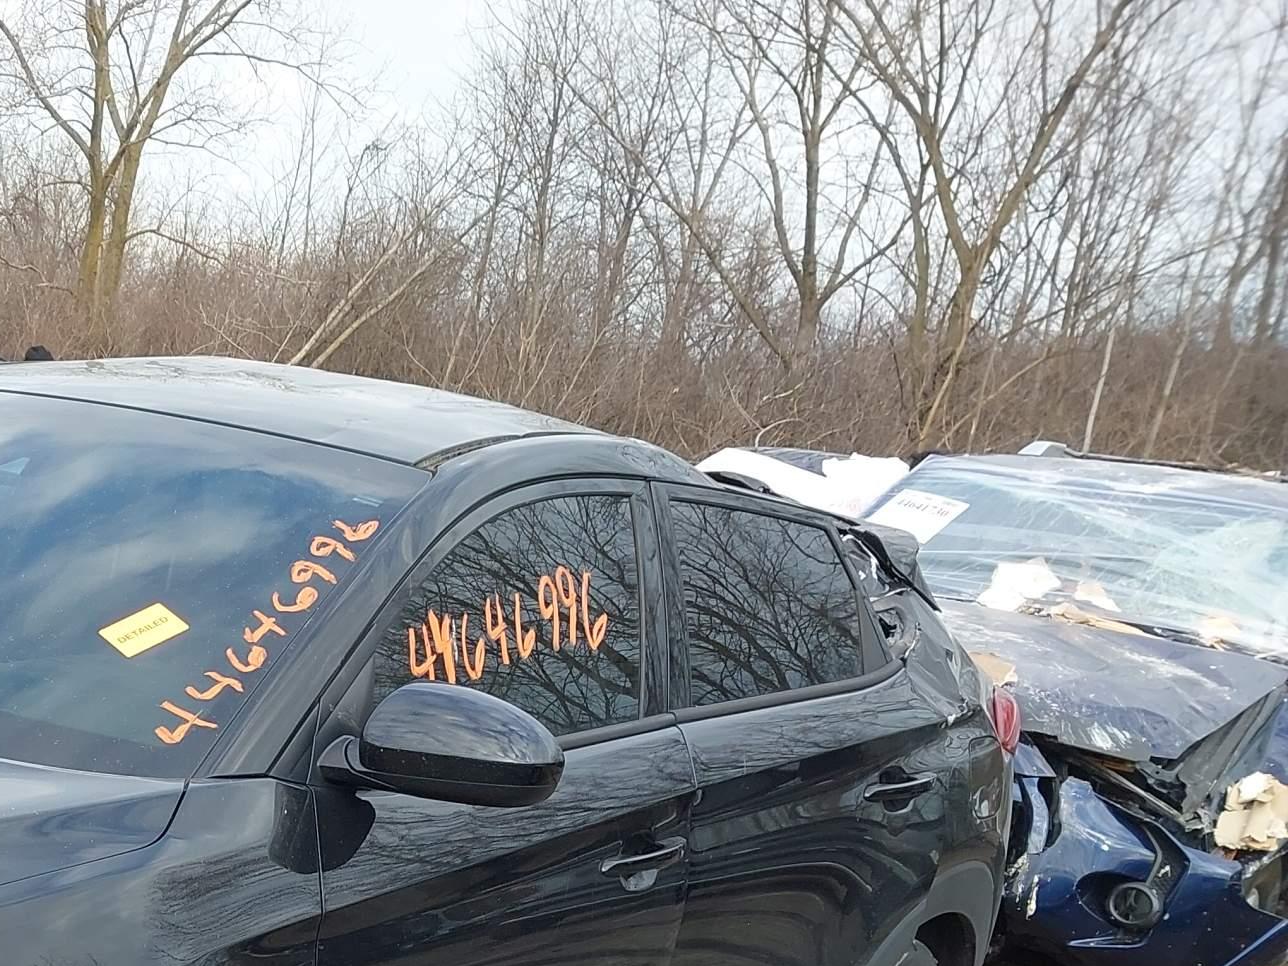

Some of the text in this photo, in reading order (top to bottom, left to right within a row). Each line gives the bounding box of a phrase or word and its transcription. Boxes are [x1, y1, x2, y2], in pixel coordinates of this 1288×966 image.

[116, 616, 169, 644] DETAILED
[154, 519, 380, 744] 44646996
[408, 565, 608, 684] 44646996
